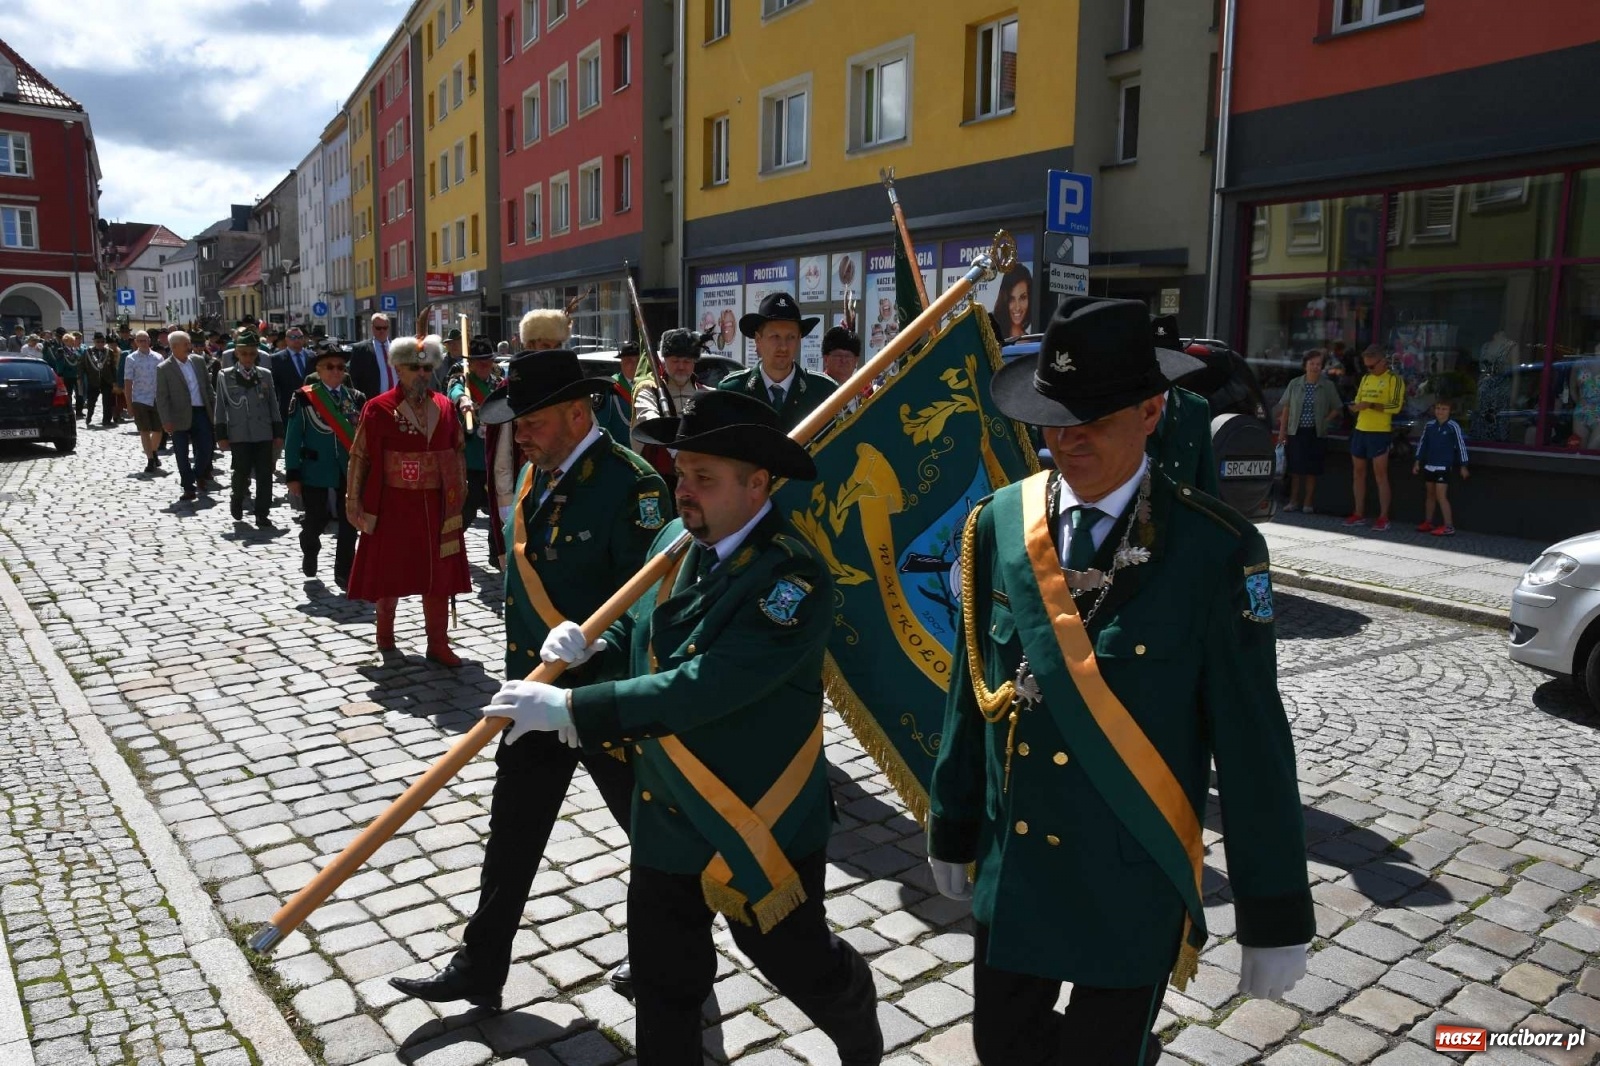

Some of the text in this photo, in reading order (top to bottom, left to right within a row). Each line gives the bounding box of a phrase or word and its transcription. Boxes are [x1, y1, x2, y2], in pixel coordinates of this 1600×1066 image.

[1059, 179, 1084, 225] P
[870, 251, 933, 270] STOMAGIA
[700, 271, 739, 285] STOMATOLOGIA
[753, 266, 788, 280] PROTETYKA
[1051, 268, 1061, 277] dla
[121, 290, 132, 304] P
[384, 296, 395, 310] P
[1164, 295, 1176, 307] 52
[1227, 461, 1270, 475] SRC 4YV4
[884, 574, 952, 683] MIKOŁO
[921, 610, 947, 637] 2007
